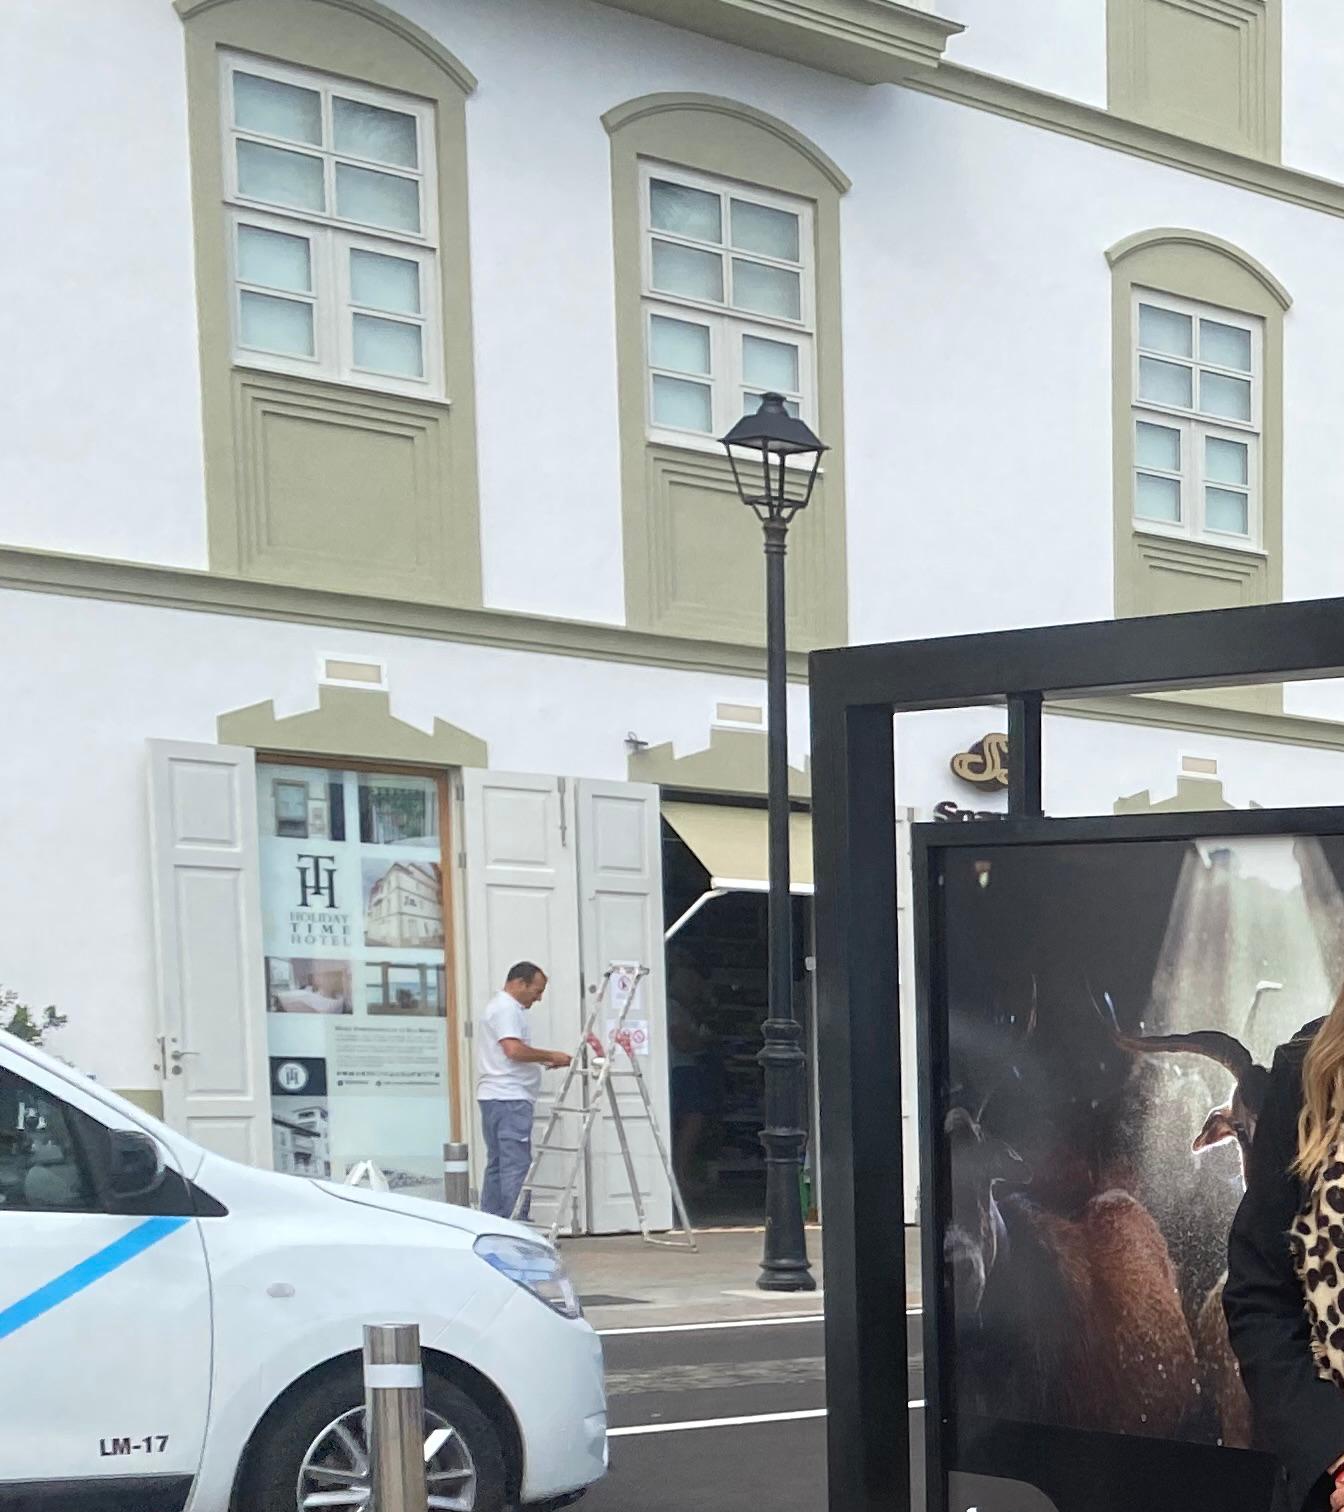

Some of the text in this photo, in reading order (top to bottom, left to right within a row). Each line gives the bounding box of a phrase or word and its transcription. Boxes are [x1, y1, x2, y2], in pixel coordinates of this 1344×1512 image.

[290, 911, 350, 924] HOLIDAY
[291, 922, 351, 935] TIME
[291, 934, 352, 946] HOTEL
[100, 1435, 169, 1456] LM-17
